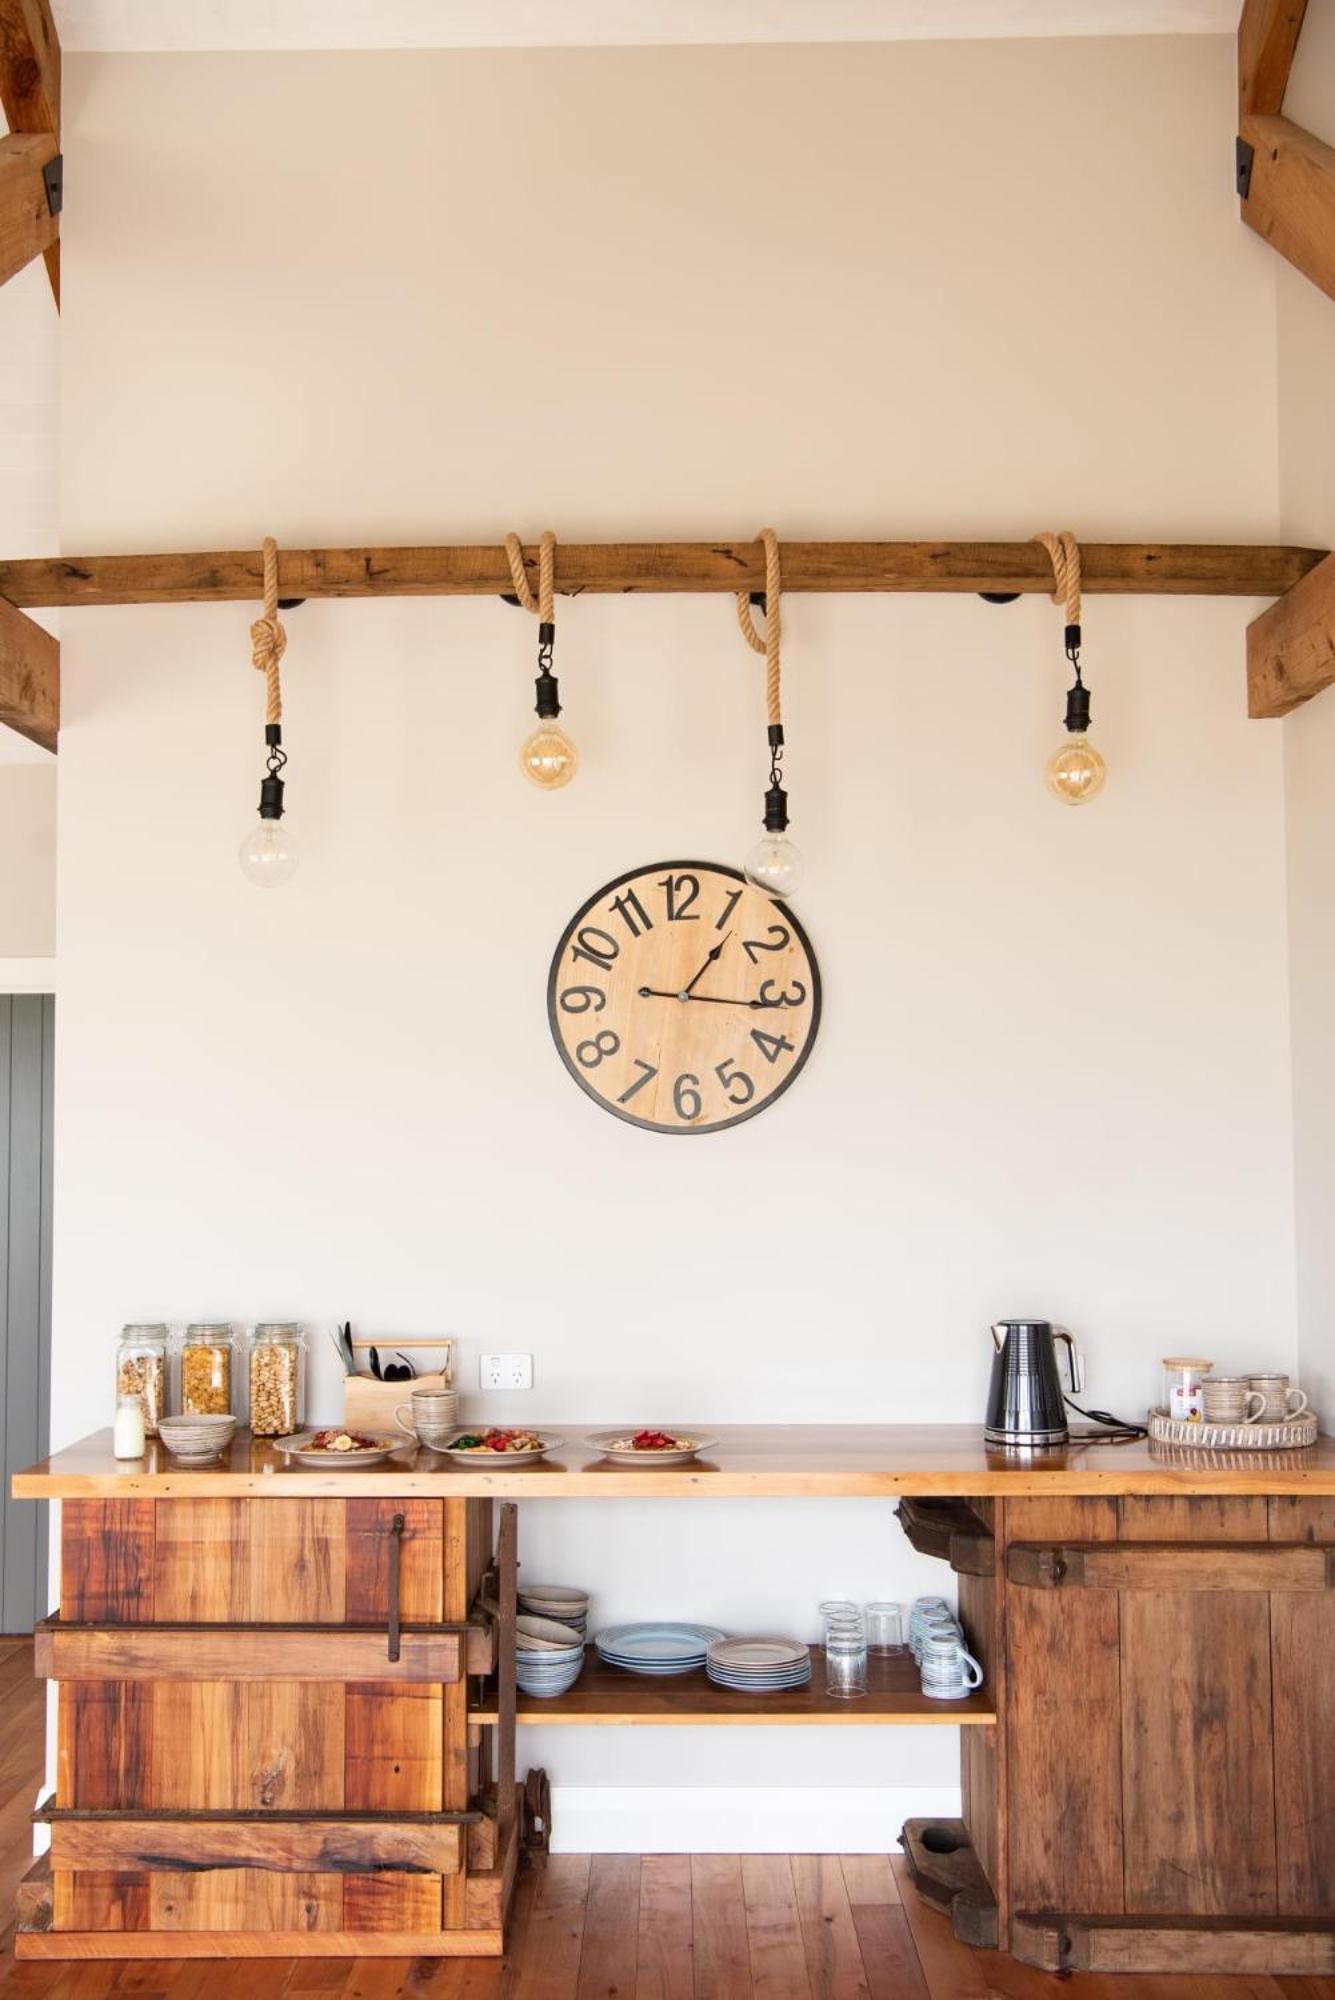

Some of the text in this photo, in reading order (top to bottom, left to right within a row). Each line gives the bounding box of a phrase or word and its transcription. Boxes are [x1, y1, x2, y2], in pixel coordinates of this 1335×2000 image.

[609, 888, 653, 938] 11
[658, 874, 700, 921] 12
[716, 889, 743, 931] 1
[571, 927, 620, 971] 10
[742, 925, 790, 964] 2
[560, 986, 606, 1014] 9
[759, 979, 806, 1008] 3
[576, 1030, 620, 1068] 8
[750, 1028, 795, 1063] 4
[617, 1059, 658, 1104] 7
[673, 1073, 702, 1120] 6
[715, 1058, 755, 1104] 5
